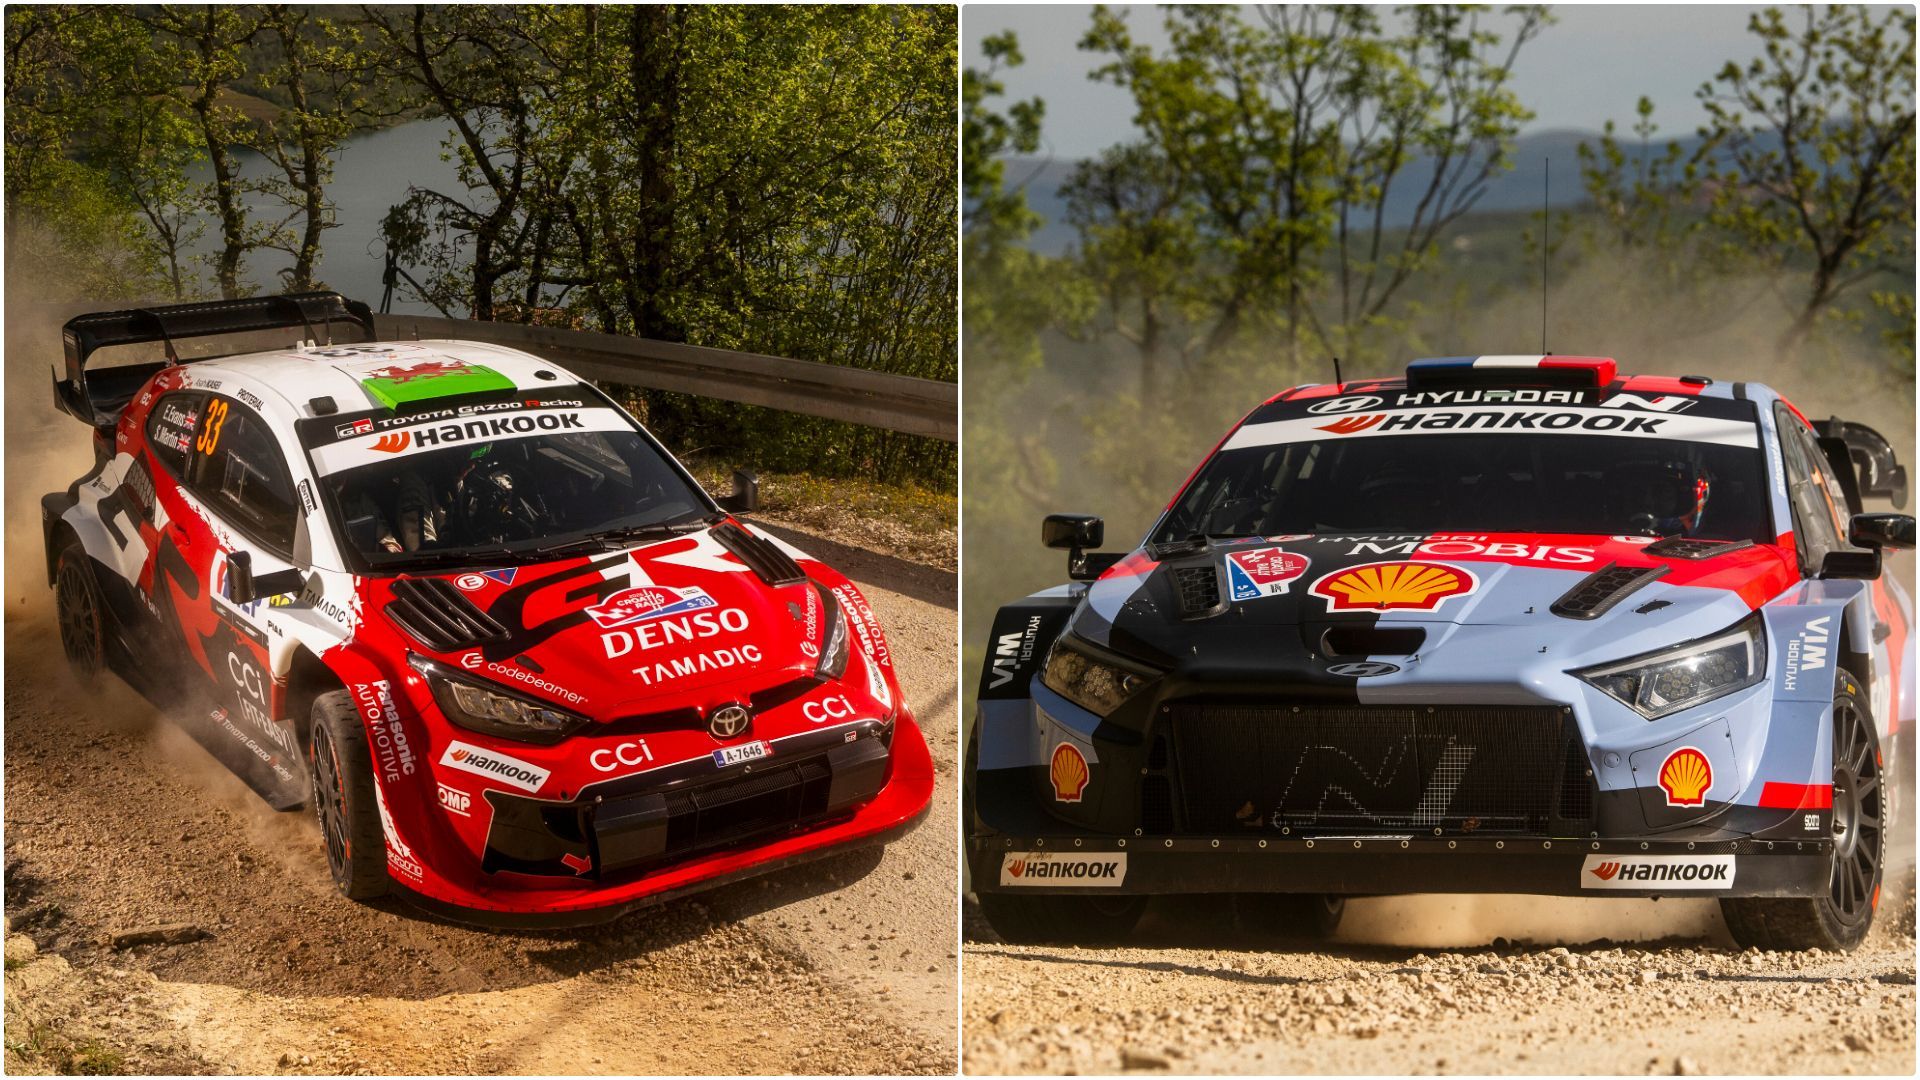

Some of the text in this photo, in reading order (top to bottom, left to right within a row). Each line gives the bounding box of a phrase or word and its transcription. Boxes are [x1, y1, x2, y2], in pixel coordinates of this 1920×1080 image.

[162, 404, 187, 427] E.Evans
[378, 408, 453, 426] TOYOTA
[457, 398, 522, 418] GAZOO
[525, 398, 584, 409] Racing
[1396, 390, 1585, 406] HYUNDAI
[196, 398, 229, 456] 33
[1318, 535, 1489, 543] HYUNDAI
[1344, 541, 1597, 564] MOBIS
[304, 588, 347, 623] TAMADIC
[616, 593, 666, 607] CROATIA
[635, 597, 666, 609] RALLY
[803, 588, 818, 641] codebeamer
[600, 608, 750, 660] DENSO
[839, 582, 891, 667] AUTOMOTIVE
[1020, 615, 1042, 662] HYUNDAI
[487, 661, 586, 705] codebeamer
[632, 644, 763, 686] TAMADIC
[1784, 639, 1801, 691] HYUNDAI
[222, 718, 249, 743] TOYOTA
[245, 739, 272, 763] GAZOO
[354, 683, 401, 784] AUTOMOTIVE
[372, 679, 417, 776] Panasonic
[726, 744, 762, 762] A-7646
[437, 787, 471, 811] OMP
